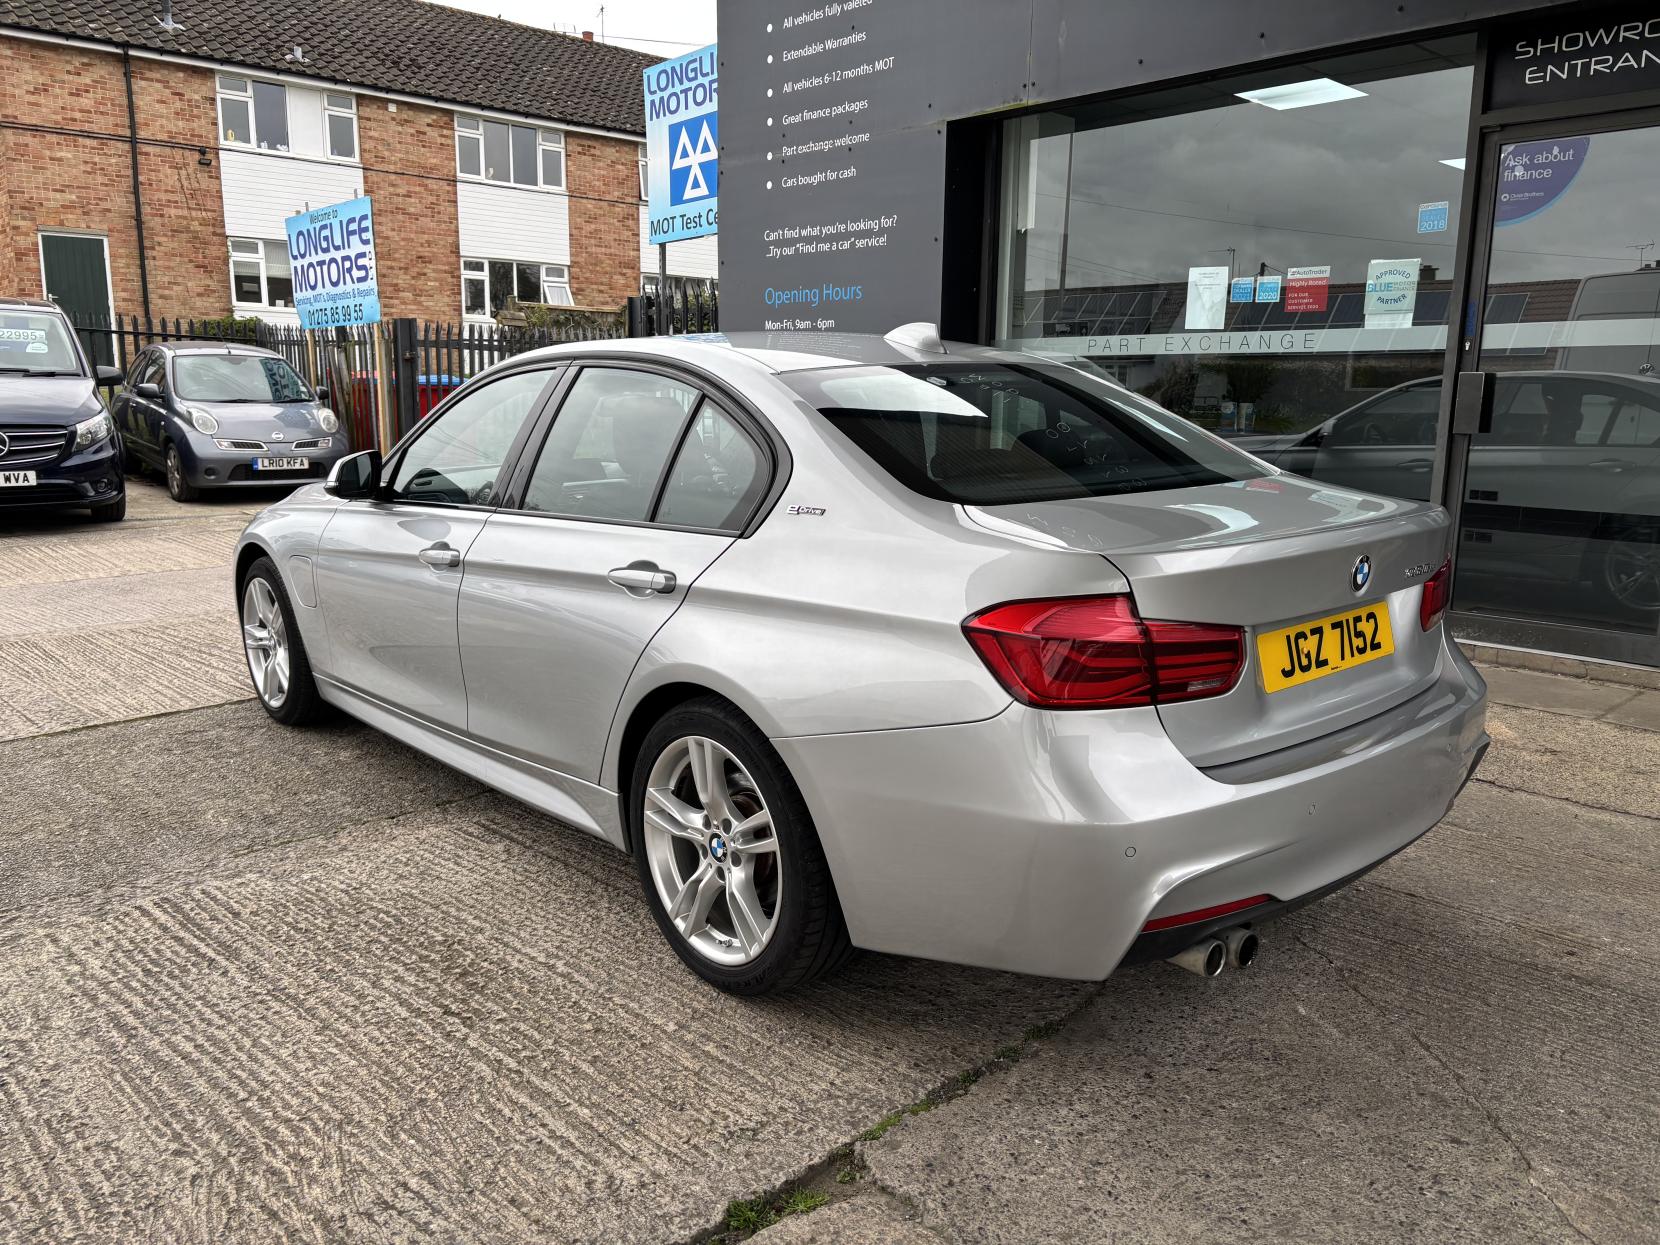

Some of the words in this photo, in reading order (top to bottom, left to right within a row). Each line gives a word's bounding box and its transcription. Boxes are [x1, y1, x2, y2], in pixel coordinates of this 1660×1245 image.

[783, 17, 793, 29] All
[794, 9, 824, 25] vehicles
[825, 2, 841, 16] fully
[783, 42, 824, 62] Extendable
[825, 31, 867, 50] Warranties
[783, 82, 792, 94] All
[794, 76, 823, 91] vehicles
[824, 71, 841, 84] 6-12
[843, 63, 873, 80] months
[874, 57, 894, 72] MOT
[782, 112, 802, 124] Great
[804, 108, 830, 120] finance
[832, 100, 868, 117] packages
[782, 146, 796, 156] Part
[798, 140, 834, 154] exchange
[834, 133, 870, 147] welcome
[1505, 153, 1530, 166] Ask
[1534, 148, 1574, 164] about
[782, 177, 797, 188] Cars
[798, 172, 826, 186] bought
[826, 170, 838, 180] for
[838, 166, 856, 178] cash
[1504, 168, 1552, 182] finance
[310, 210, 332, 225] Welcome
[332, 209, 338, 219] to
[650, 216, 676, 236] MOT
[680, 212, 702, 231] Test
[764, 229, 782, 241] Can't
[784, 226, 800, 238] find
[800, 225, 820, 237] what
[822, 222, 846, 238] you're
[848, 219, 879, 232] looking
[880, 214, 898, 228] for?
[1420, 220, 1446, 230] 2018
[288, 214, 370, 260] LONGLIFE
[782, 246, 796, 256] our
[818, 243, 830, 252] me
[832, 242, 837, 250] a
[855, 234, 887, 248] service!
[293, 251, 370, 294] MOTORS
[1376, 270, 1410, 280] APPROVED
[326, 289, 352, 304] Diagnostics
[352, 288, 356, 298] &
[765, 285, 820, 308] Opening
[823, 283, 863, 300] Hours
[1368, 282, 1393, 292] BLUE
[1377, 294, 1408, 304] PARTNER
[308, 308, 328, 326] 01275
[330, 306, 340, 324] 85
[342, 304, 352, 322] 99
[354, 303, 363, 320] 55
[765, 320, 794, 331] Mon-Fri,
[795, 319, 812, 329] 9am
[817, 318, 835, 330] 6pm
[1087, 337, 1146, 353] PART
[1164, 333, 1316, 352] EXCHANGE
[261, 458, 285, 468] LR10
[286, 457, 306, 468] KFA
[3, 473, 30, 485] WVA
[1280, 625, 1329, 679] JGZ
[1331, 612, 1382, 662] 7152
